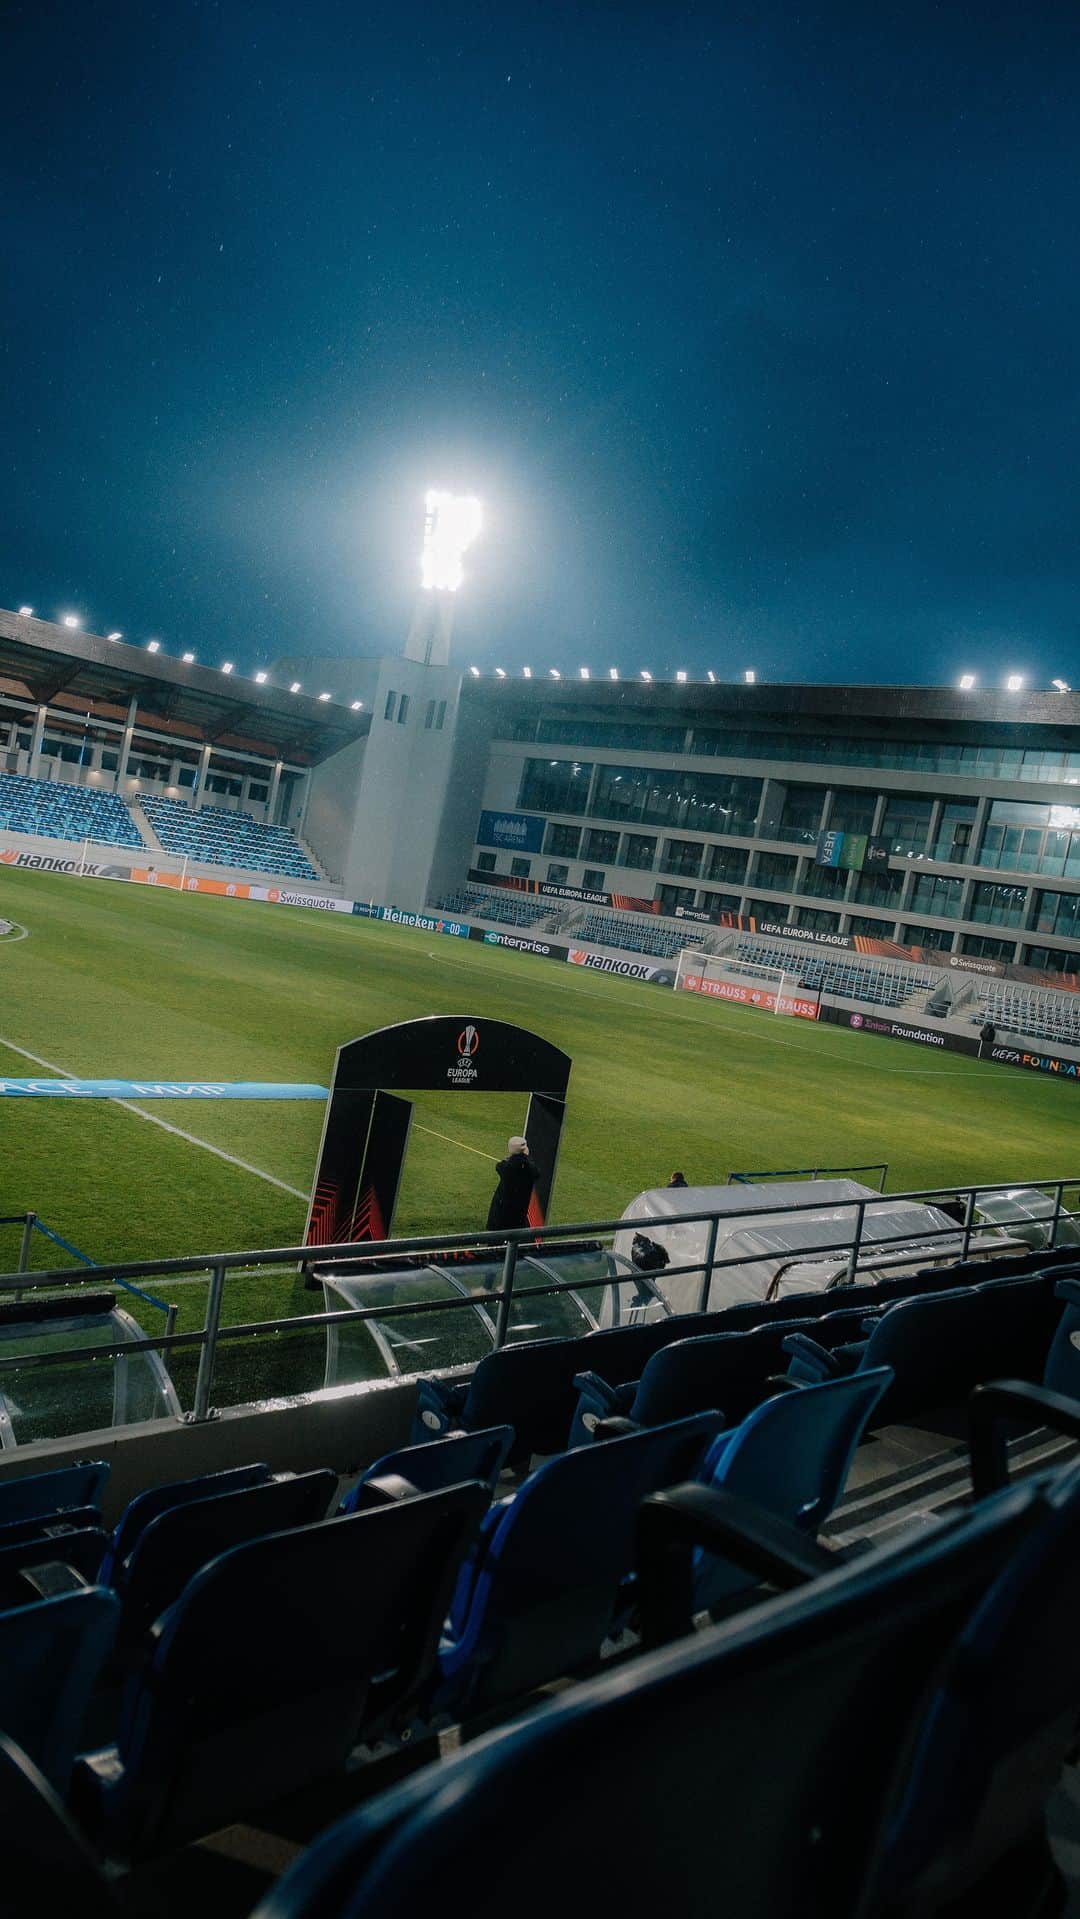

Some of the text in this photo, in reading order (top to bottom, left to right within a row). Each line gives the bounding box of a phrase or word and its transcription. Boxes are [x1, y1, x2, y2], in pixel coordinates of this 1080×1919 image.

[821, 831, 837, 865] UEFA
[280, 890, 336, 910] Swissquote
[542, 885, 609, 904] UEFA EUROPA LEAGUE
[383, 907, 434, 930] Heineken
[485, 932, 550, 955] enterprise
[760, 922, 849, 946] UEFA EUROPA LEAGUE
[701, 980, 747, 1000] STRAUSS
[891, 1024, 944, 1045] Foundation
[991, 1047, 1020, 1062] UEFA
[447, 1068, 478, 1078] EUROPA
